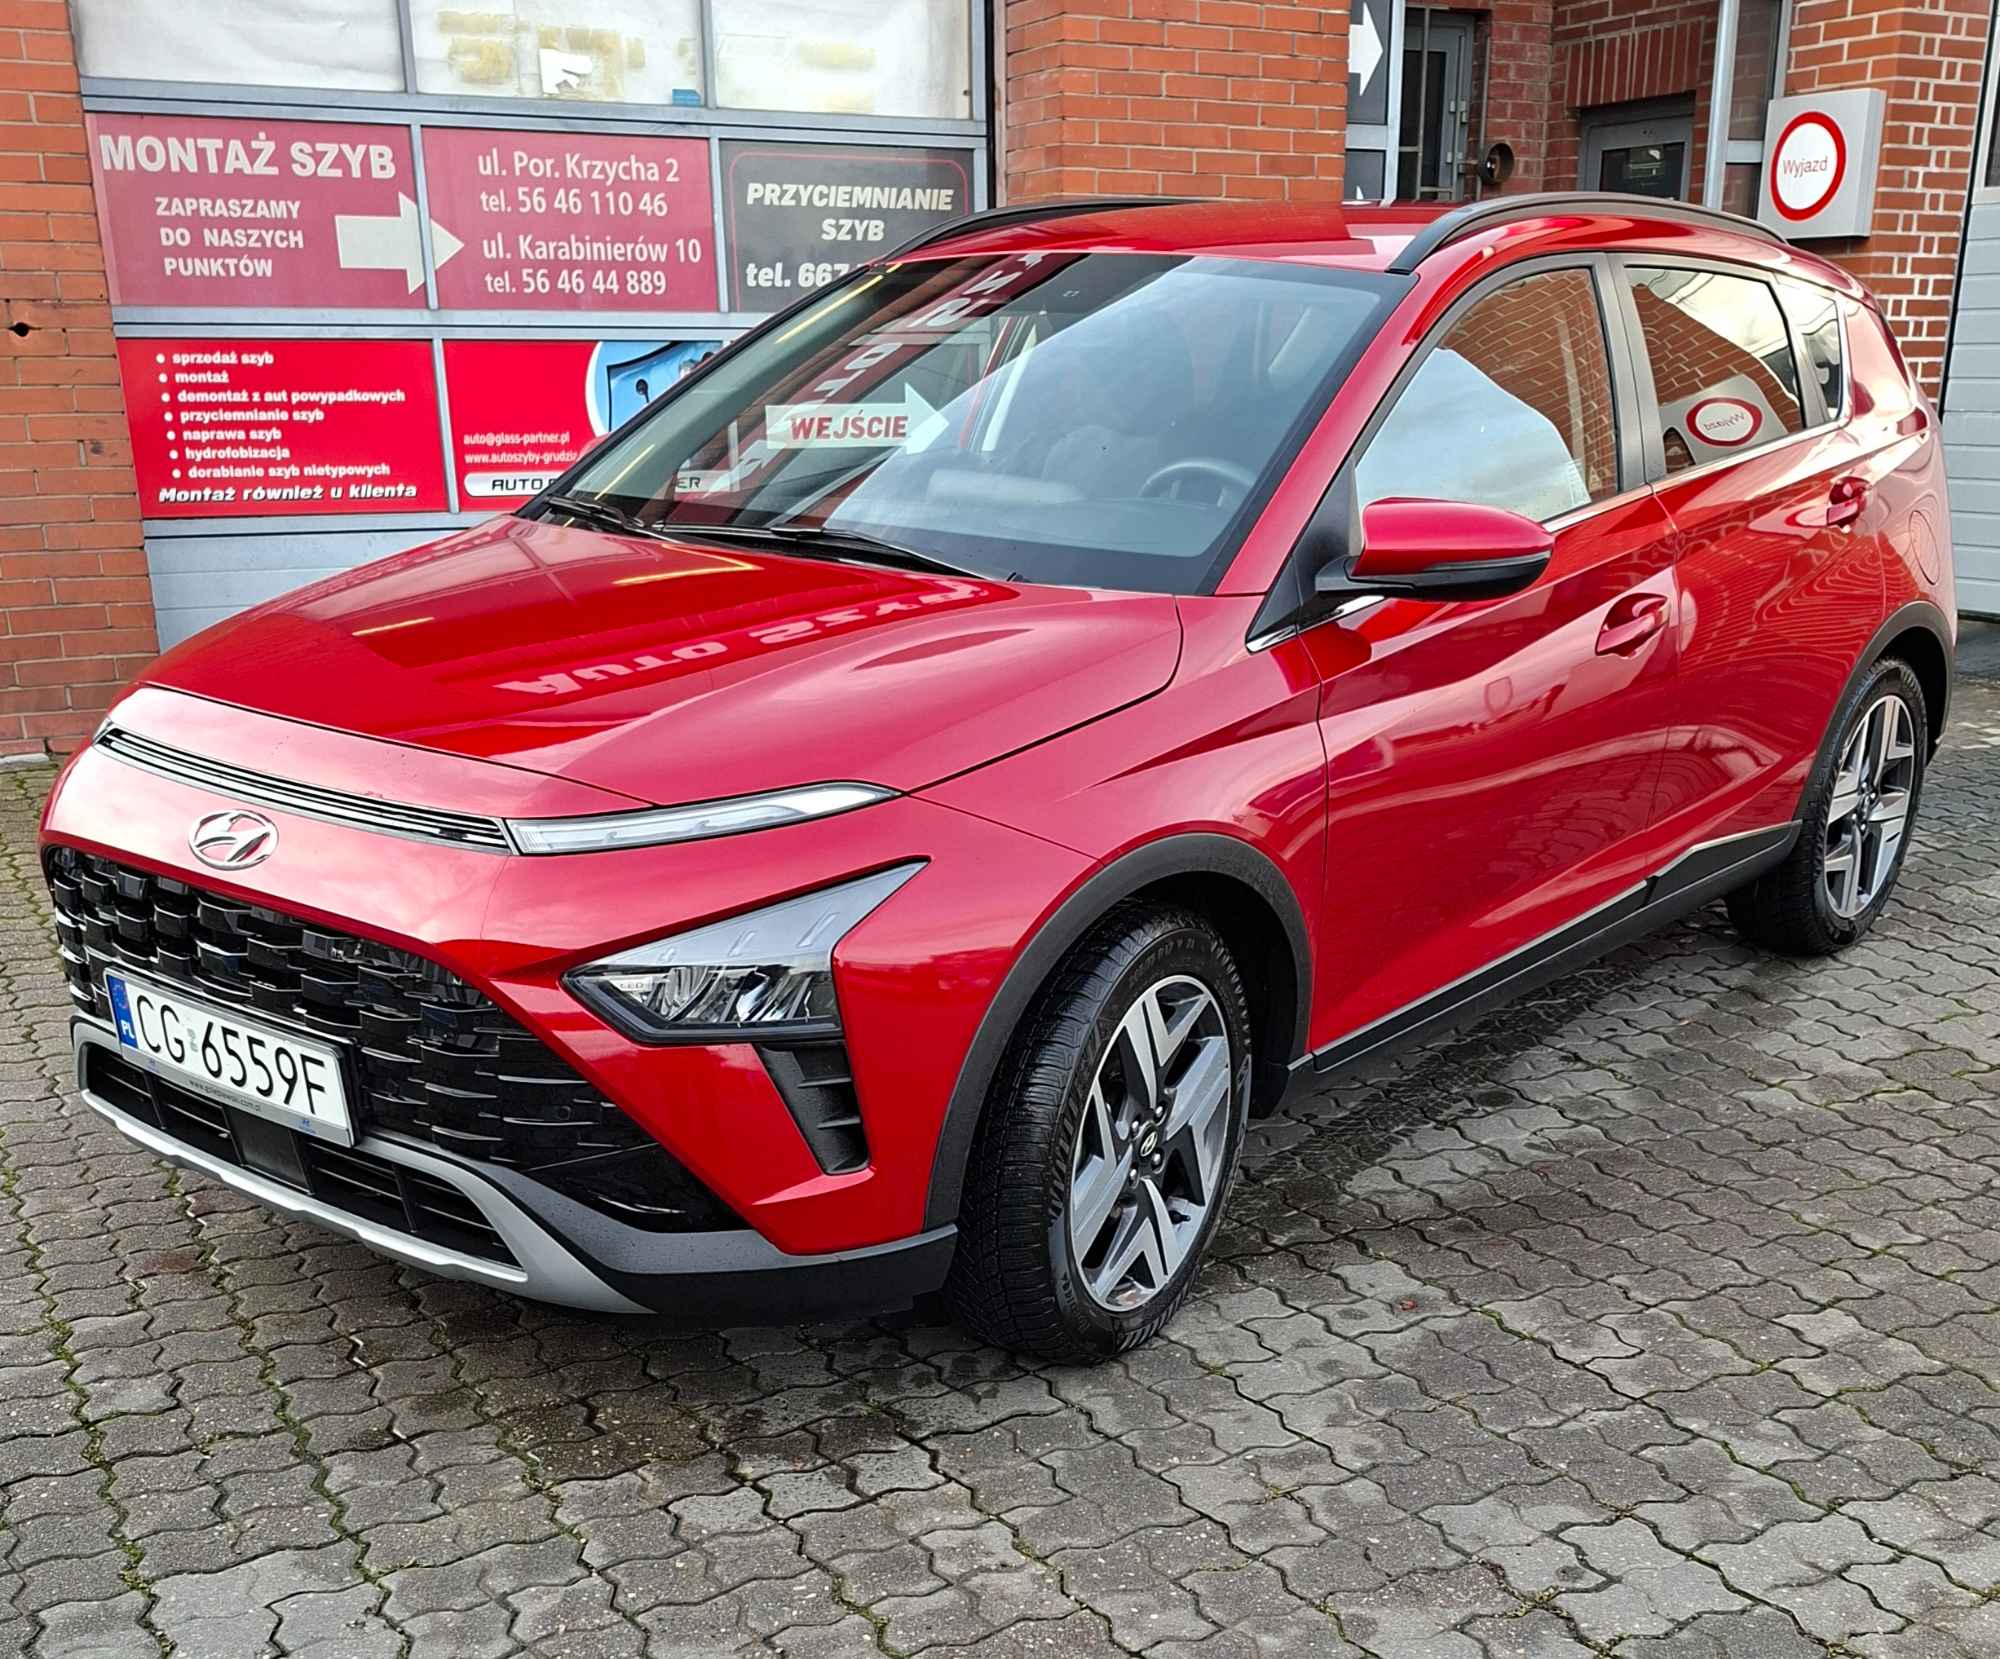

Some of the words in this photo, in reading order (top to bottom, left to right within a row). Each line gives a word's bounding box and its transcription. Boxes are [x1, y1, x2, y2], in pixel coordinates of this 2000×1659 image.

[99, 132, 280, 175] MONTAŻ
[290, 142, 396, 180] SZYB
[478, 147, 507, 176] ul.
[514, 151, 560, 179] Por.
[566, 152, 660, 186] Krzycha
[665, 158, 680, 183] 2
[1783, 155, 1828, 178] Wyjazd
[155, 196, 301, 219] ZAPRASZAMY
[480, 188, 512, 213] tel.
[517, 186, 546, 214] 56
[553, 188, 582, 214] 46
[590, 190, 633, 216] 110
[639, 193, 668, 217] 46
[746, 182, 955, 211] PRZYCIEMNIANIE
[160, 227, 191, 247] DO
[204, 229, 304, 249] NASZYCH
[821, 219, 885, 242] SZYB
[483, 231, 511, 260] ul.
[519, 234, 668, 263] Karabinierów
[675, 238, 701, 263] 10
[163, 254, 273, 278] PUNKTÓW
[746, 261, 792, 288] tel.
[485, 271, 517, 294] tel.
[522, 268, 551, 294] 56
[557, 269, 585, 294] 46
[592, 270, 620, 295] 44
[626, 270, 667, 295] 889
[172, 351, 238, 366] sprzedaż
[241, 351, 274, 366] szyb
[175, 371, 229, 384] montaż
[177, 389, 249, 403] demontaż
[252, 391, 261, 402] z
[264, 390, 288, 402] aut
[291, 389, 406, 404] powypadkowych
[180, 409, 289, 424] przyciemnianie
[292, 409, 324, 424] szyb
[789, 409, 909, 441] WEJŚCIE
[183, 429, 246, 443] naprawa
[249, 428, 282, 442] szyb
[463, 431, 570, 446] auto@glass-partner.pl
[185, 446, 291, 461] hydrofobizacja
[188, 465, 265, 479] dorabianie
[268, 465, 300, 479] szyb
[303, 464, 391, 479] nietypowych
[158, 487, 236, 503] Montaż
[242, 485, 324, 502] również
[330, 488, 343, 500] u
[349, 484, 417, 499] klienta
[491, 478, 543, 491] AUTO
[120, 1020, 135, 1039] PL
[136, 994, 185, 1064] CG
[201, 1021, 326, 1116] 6559F
